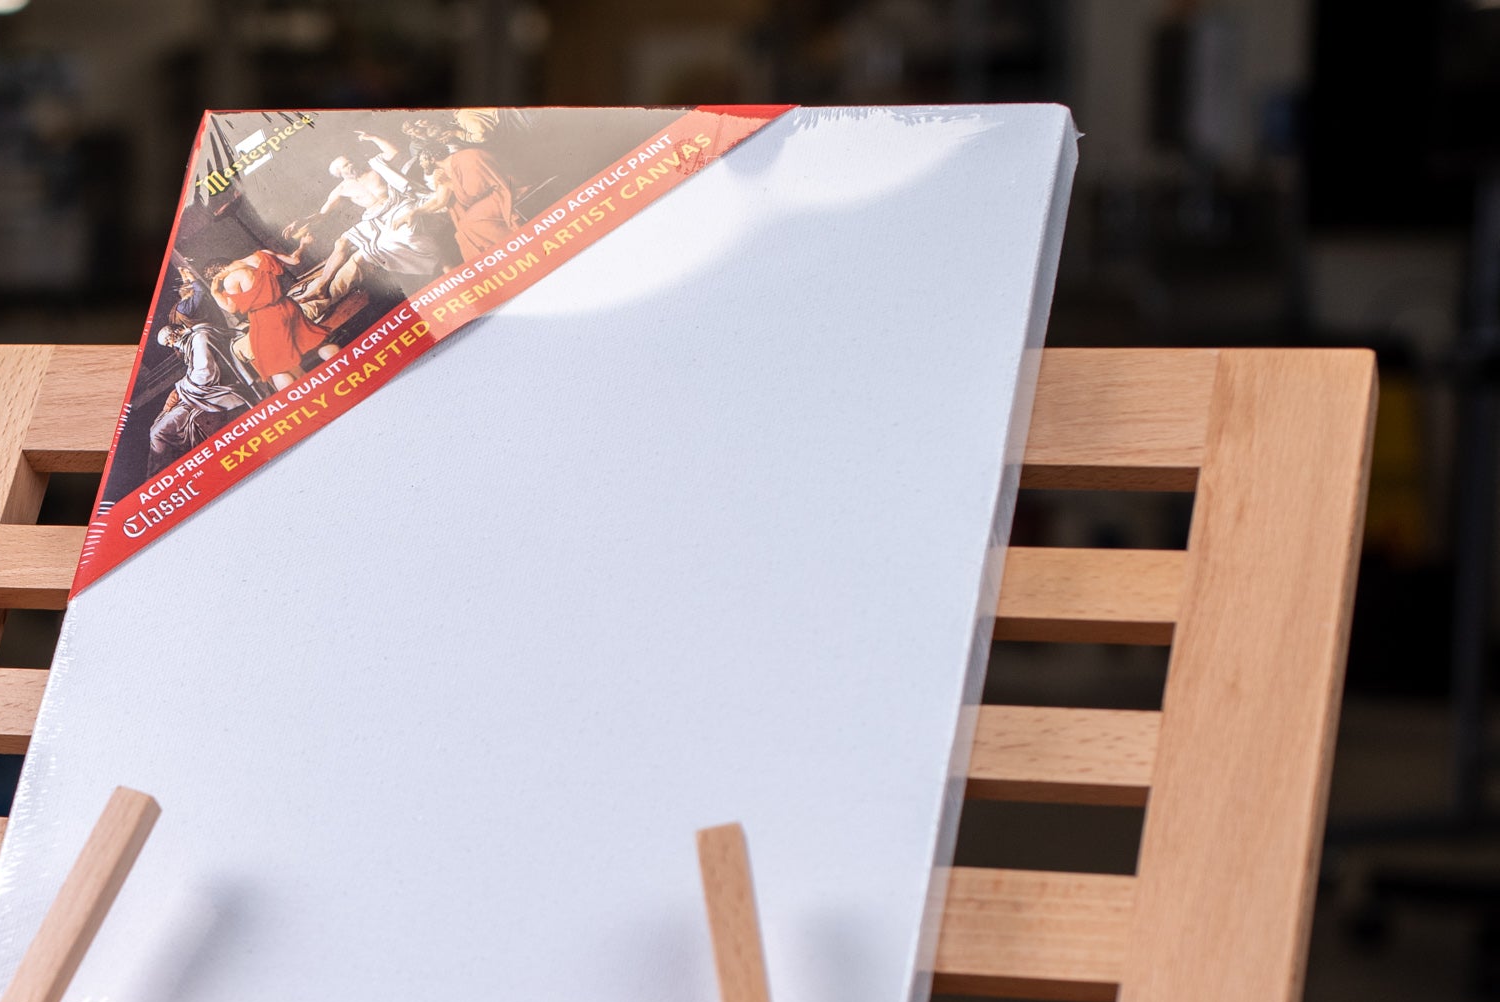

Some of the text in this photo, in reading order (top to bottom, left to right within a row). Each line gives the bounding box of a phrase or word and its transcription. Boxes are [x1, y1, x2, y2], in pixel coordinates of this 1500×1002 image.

[139, 133, 673, 505] ACID-FREE ARCHIVAL QUALITY ACRYLIC PRIMING FOR OIL AND ACRYLIC PAINT
[195, 113, 314, 196] Masterpiece
[219, 133, 712, 472] EXPERTLY CRAFTED PREMIUM ARTIST CANVAS
